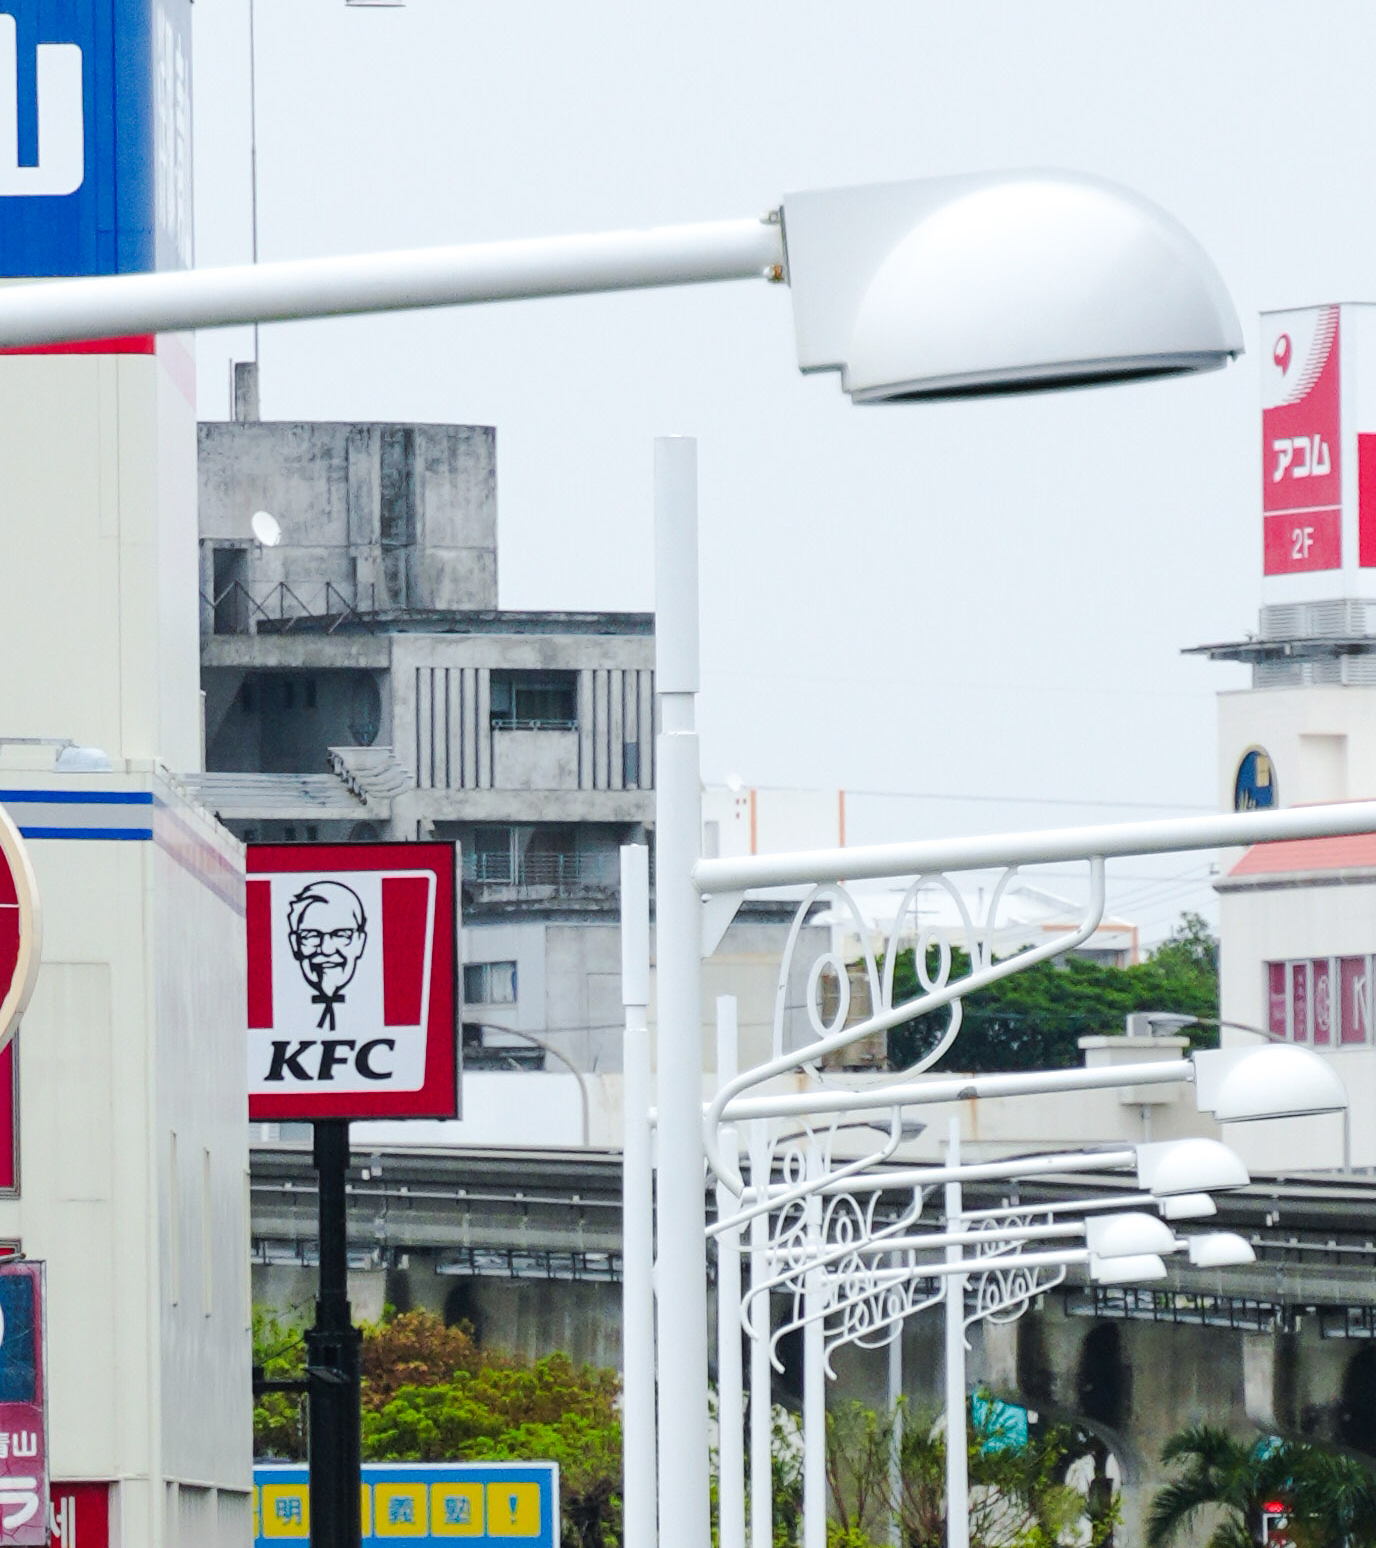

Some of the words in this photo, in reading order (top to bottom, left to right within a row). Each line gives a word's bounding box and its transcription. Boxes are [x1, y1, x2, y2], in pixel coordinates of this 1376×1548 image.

[1273, 433, 1331, 479] アコム
[1291, 528, 1315, 559] 2F
[264, 1038, 396, 1082] KFC
